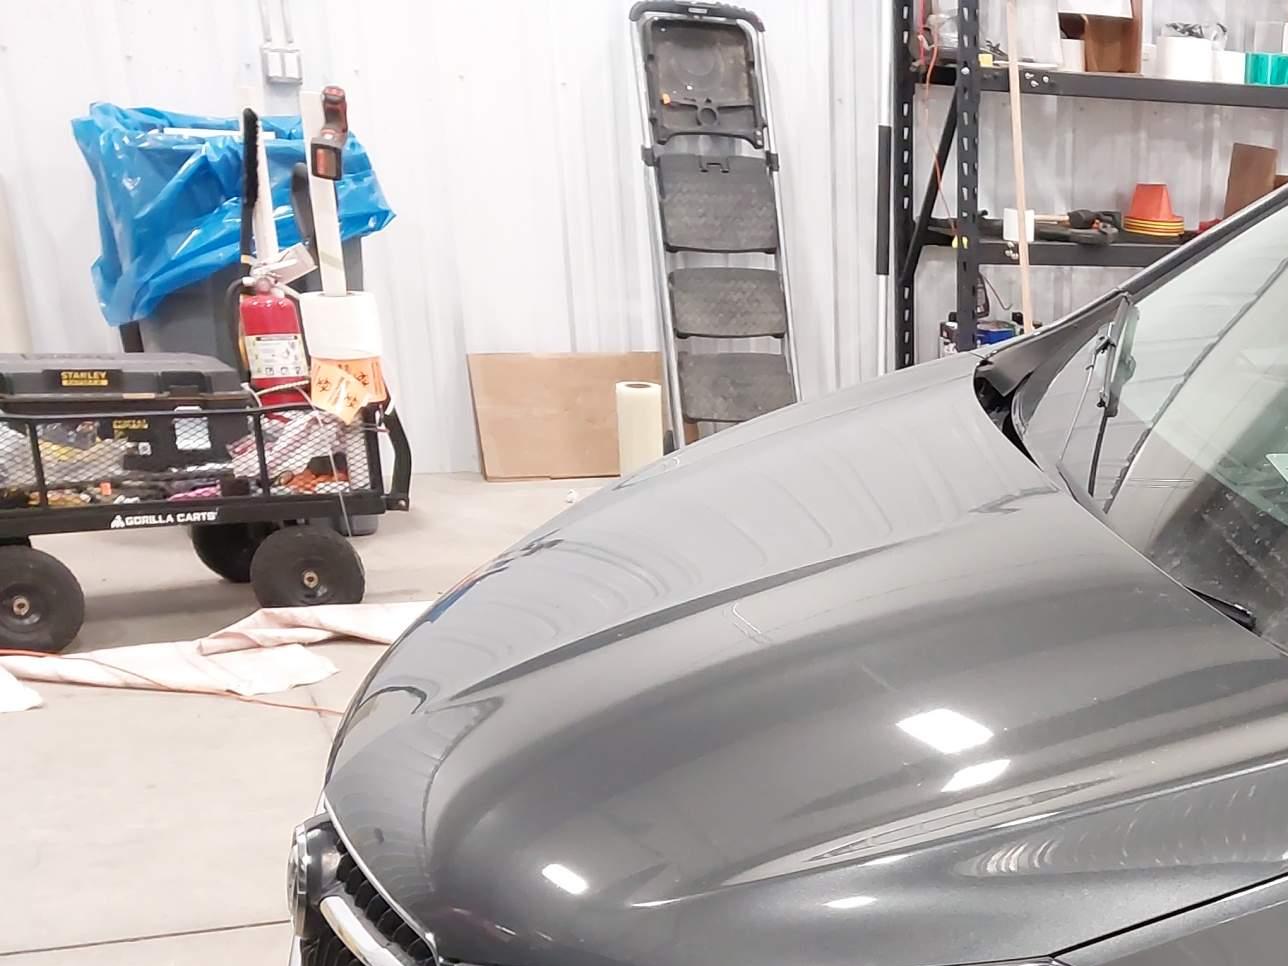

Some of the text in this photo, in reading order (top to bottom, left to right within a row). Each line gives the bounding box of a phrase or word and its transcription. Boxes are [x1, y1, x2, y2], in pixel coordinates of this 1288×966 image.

[60, 371, 107, 380] STANLEY
[124, 511, 217, 526] GORILLA CARTS
